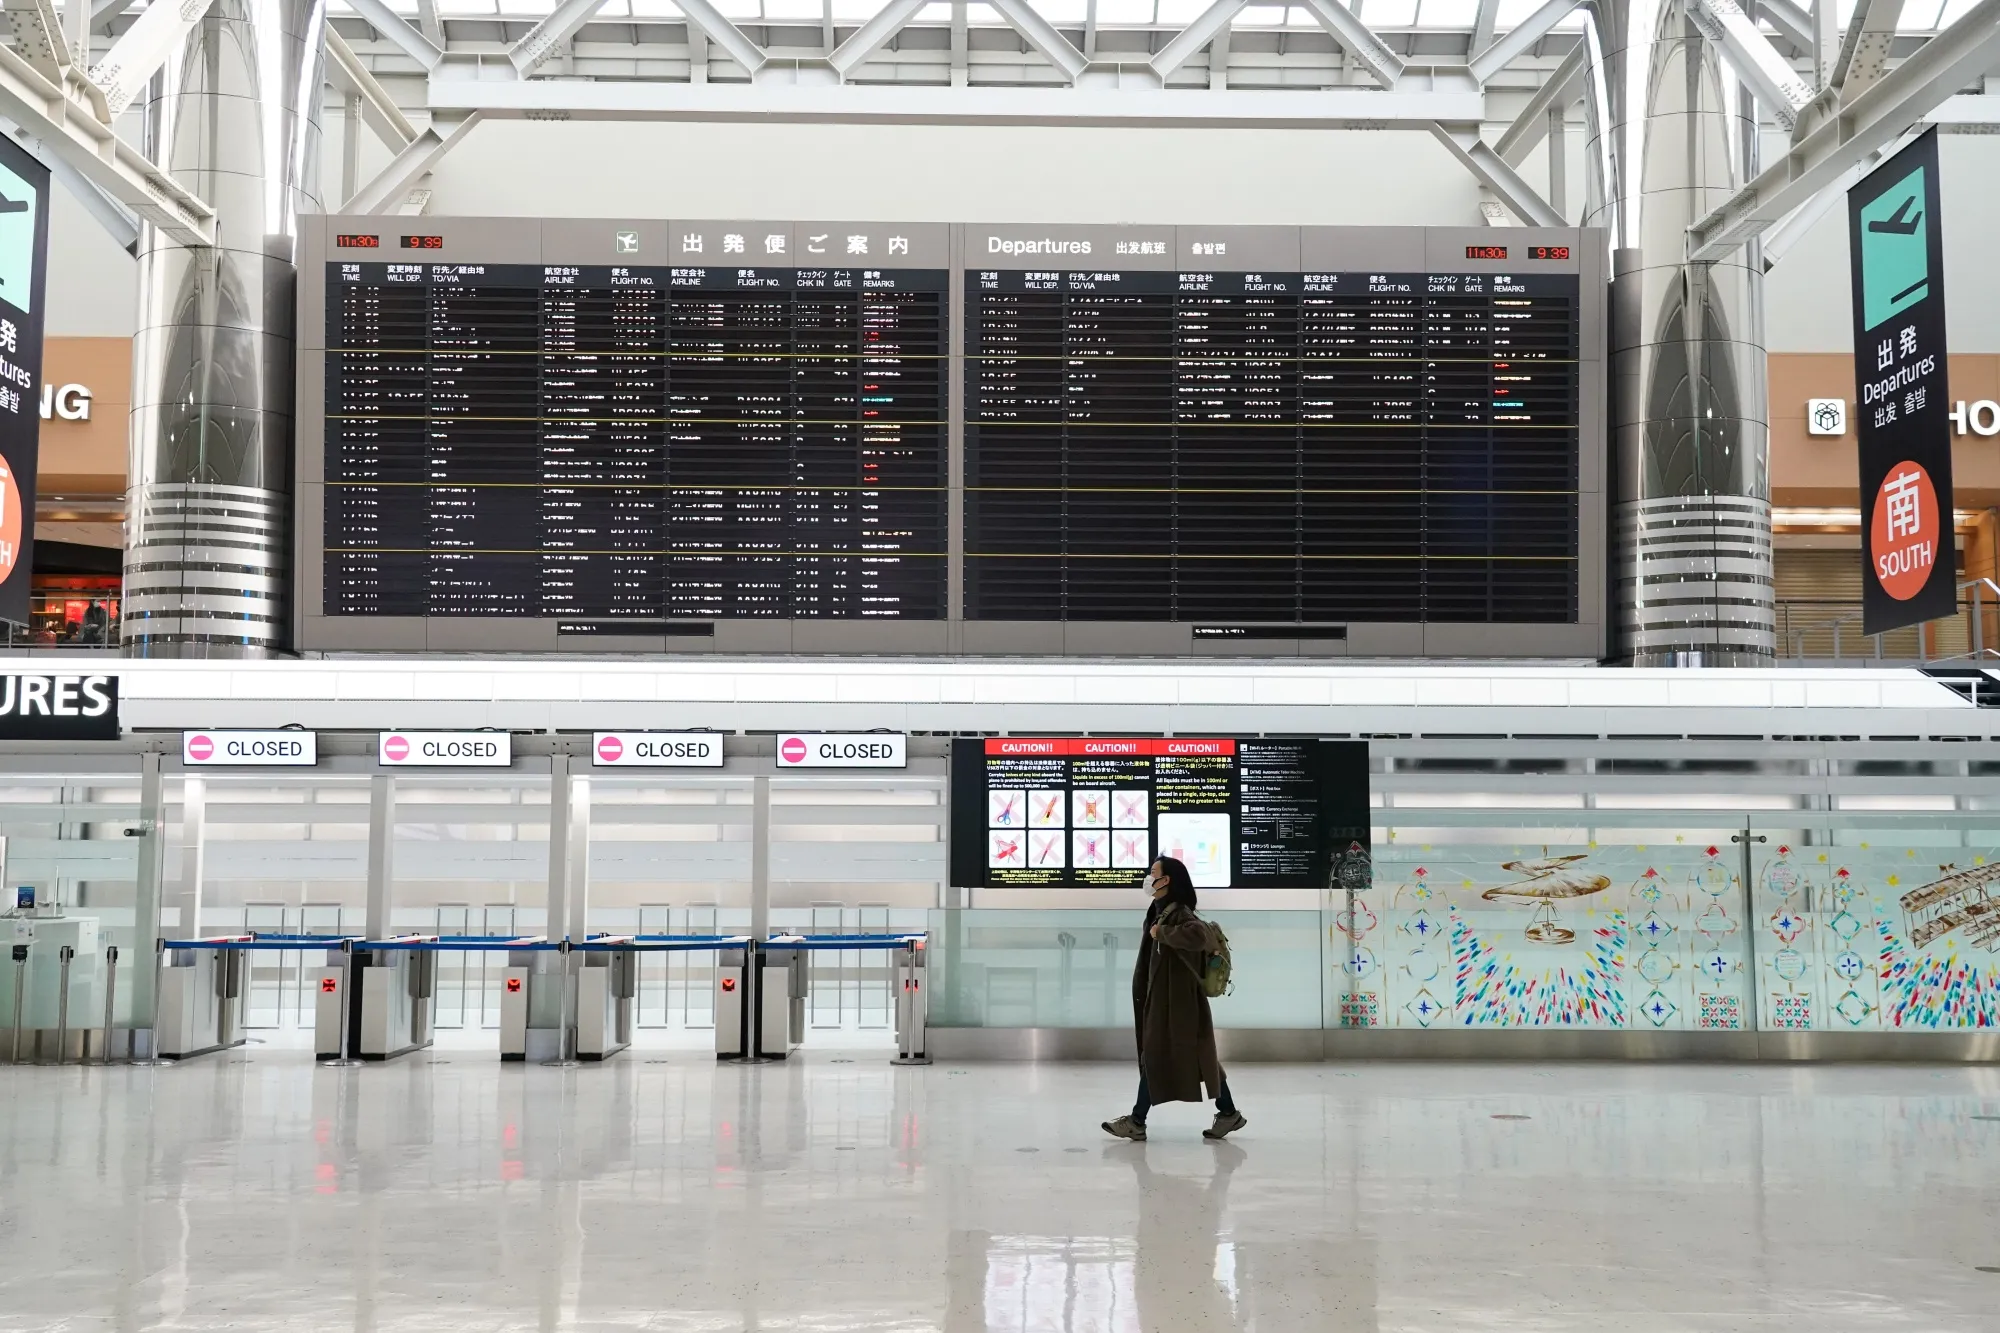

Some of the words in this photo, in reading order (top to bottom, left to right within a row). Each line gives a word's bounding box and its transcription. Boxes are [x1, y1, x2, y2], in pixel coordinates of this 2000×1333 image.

[683, 234, 908, 254] 出発便ご案内
[988, 237, 1091, 255] Departures
[1116, 242, 1166, 255] 出发航班
[1192, 243, 1225, 255] 출발편
[342, 265, 359, 273] 定刻
[388, 265, 422, 274] 変更時刻
[544, 267, 579, 276] 航空会社
[612, 268, 629, 276] 便名
[671, 269, 705, 277] 航空会社
[388, 274, 403, 282] WILL
[406, 274, 421, 282] DEP.
[738, 270, 755, 278] 便名
[834, 271, 850, 279] ゲート
[864, 271, 880, 279] 備考
[981, 272, 998, 280] 定刻
[1025, 272, 1059, 281] 変更時刻
[1179, 273, 1213, 282] 航空会社
[1245, 274, 1262, 282] 便名
[432, 275, 459, 283] TO/VIA
[544, 276, 574, 284] AIRLINE
[640, 278, 654, 286] NO.
[671, 278, 701, 286] AIRLINE
[1304, 275, 1338, 283] 航空会社
[1369, 275, 1386, 284] 便名
[1465, 276, 1482, 284] ゲート
[1494, 276, 1511, 284] 備考
[981, 281, 998, 289] TIME
[1025, 281, 1041, 289] WILL
[1043, 281, 1058, 289] DEP.
[1069, 282, 1095, 290] TO/VIA
[1179, 283, 1208, 291] AIRLINE
[1304, 284, 1333, 292] AIRLINE
[1399, 285, 1411, 293] NO.
[1465, 285, 1482, 293] GATE
[1494, 285, 1525, 293] REMARKS
[1864, 355, 1934, 404] Departures
[1904, 386, 1926, 415] 출발
[1875, 402, 1897, 428] 出发
[1884, 471, 1920, 542] 南
[1880, 540, 1931, 579] SOUTH
[227, 741, 302, 757] CLOSED
[422, 742, 498, 758] CLOSED
[636, 742, 710, 759] CLOSED
[819, 743, 892, 759] CLOSED
[1002, 743, 1053, 752] CAUTION!!
[1085, 744, 1136, 752] CAUTION!!
[1168, 744, 1219, 752] CAUTION!!
